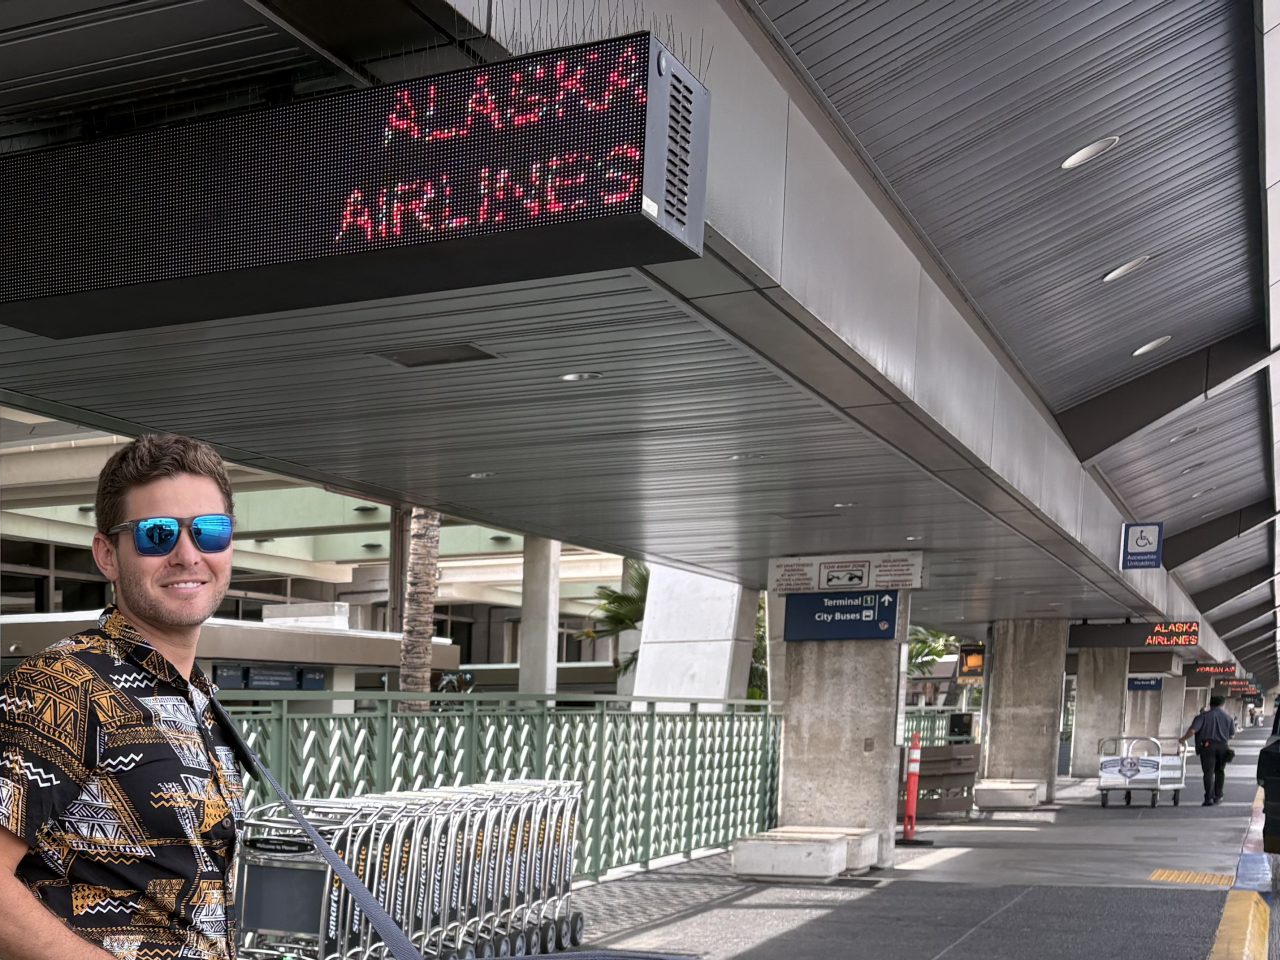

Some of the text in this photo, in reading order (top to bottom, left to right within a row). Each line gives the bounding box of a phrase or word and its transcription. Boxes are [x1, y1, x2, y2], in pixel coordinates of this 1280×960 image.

[384, 46, 648, 146] ALASKA
[334, 143, 642, 244] AIRLINES
[815, 612, 860, 622] City Buses
[824, 597, 862, 606] Terminal
[1145, 635, 1198, 645] AIRLINES
[1154, 623, 1199, 633] ALASKA
[395, 839, 410, 922] smartecarte
[416, 836, 429, 919] smartecarte
[434, 834, 446, 915] smartecarte
[452, 831, 463, 910] smartecarte
[472, 829, 483, 906] smartecarte
[487, 825, 499, 900] smartecarte
